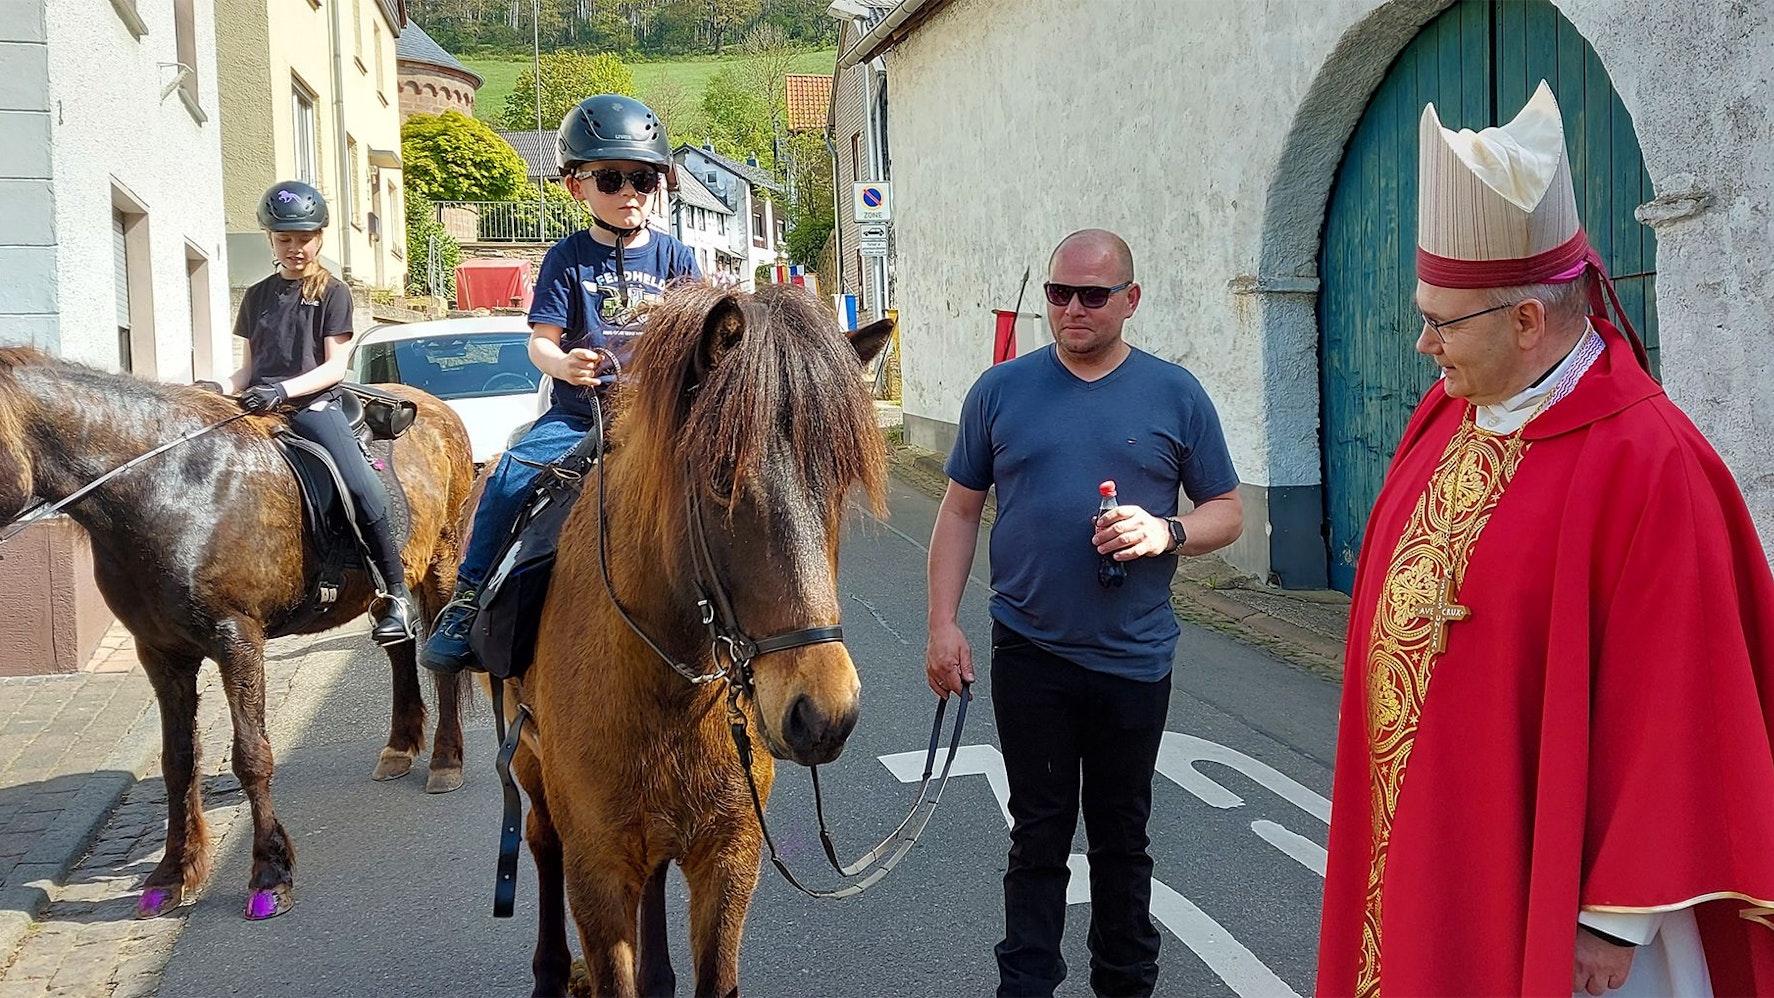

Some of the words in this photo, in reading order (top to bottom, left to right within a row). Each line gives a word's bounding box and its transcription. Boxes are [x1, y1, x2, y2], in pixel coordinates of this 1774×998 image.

[864, 211, 882, 219] ZONE
[1437, 581, 1445, 610] SPES
[1419, 607, 1434, 616] AVE
[1441, 607, 1461, 616] CRUX
[1431, 614, 1442, 649] UNICA
